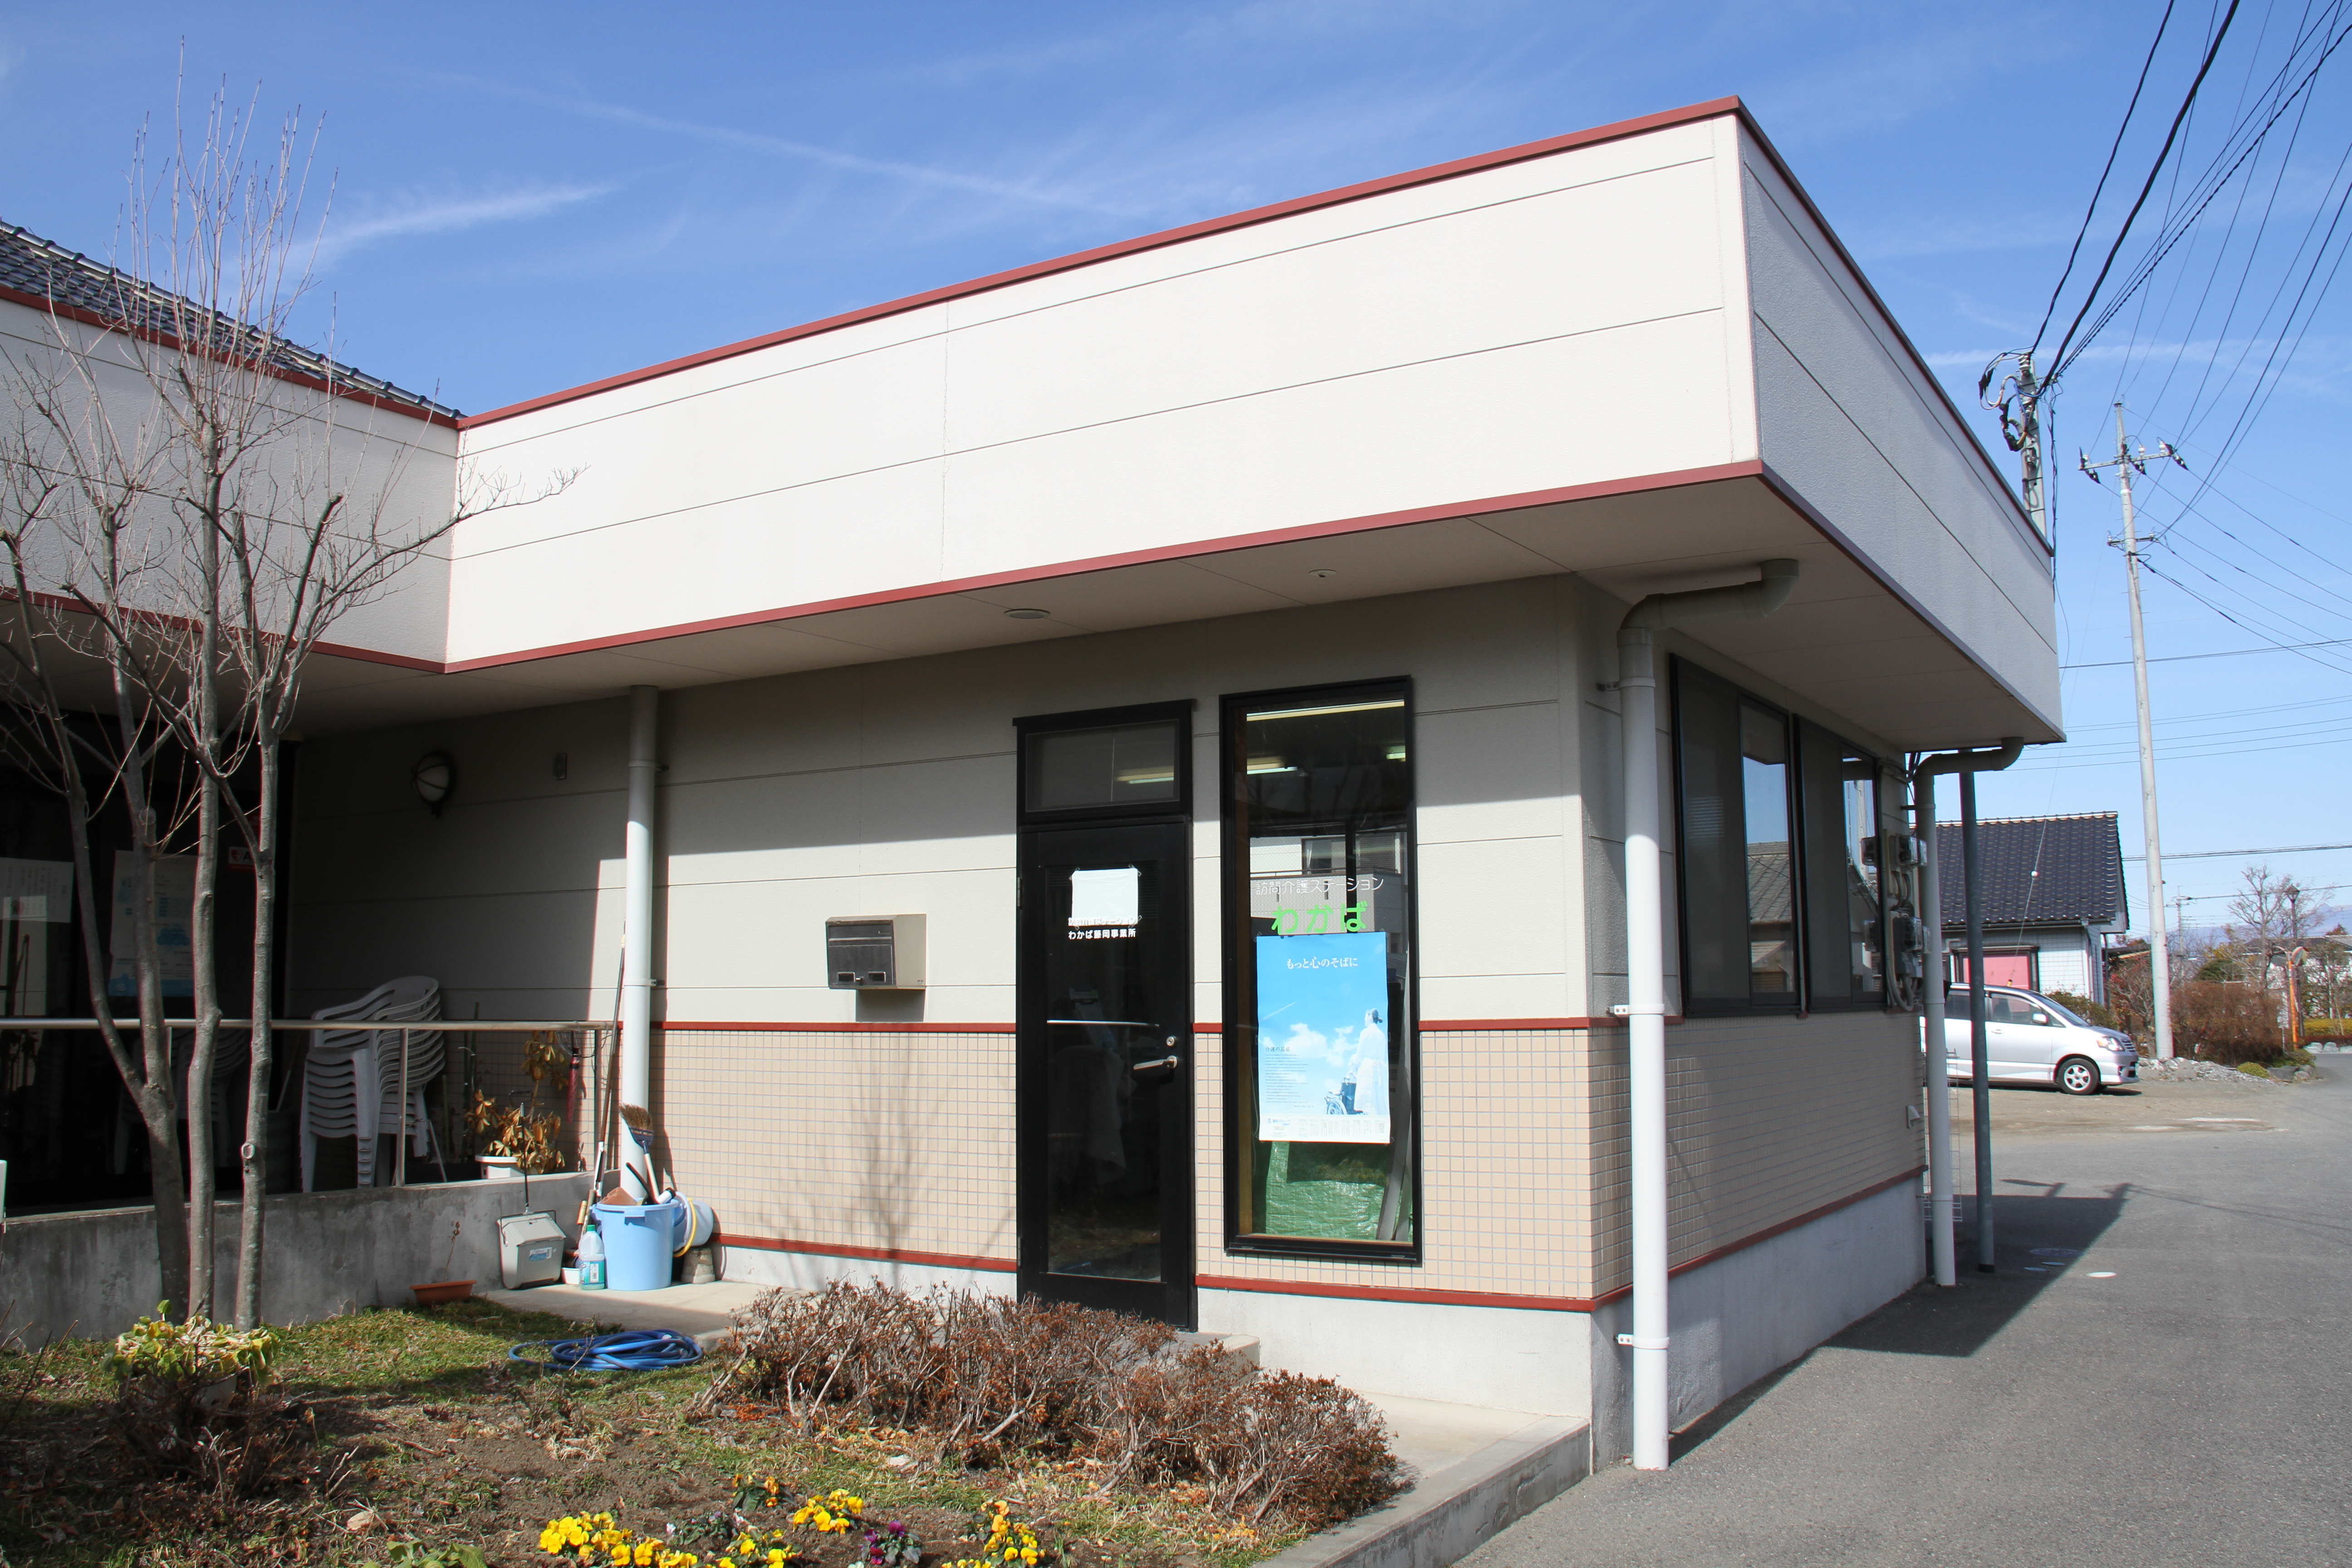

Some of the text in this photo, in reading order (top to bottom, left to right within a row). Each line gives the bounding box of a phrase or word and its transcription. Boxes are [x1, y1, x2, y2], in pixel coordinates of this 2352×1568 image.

[1256, 877, 1384, 895] 訪問介護ステーション
[1068, 916, 1137, 926] 訪問介護ステーション
[1271, 901, 1368, 935] わかば
[1068, 928, 1136, 940] わかば藤岡事業所
[1287, 956, 1358, 969] もっと心のそばに
